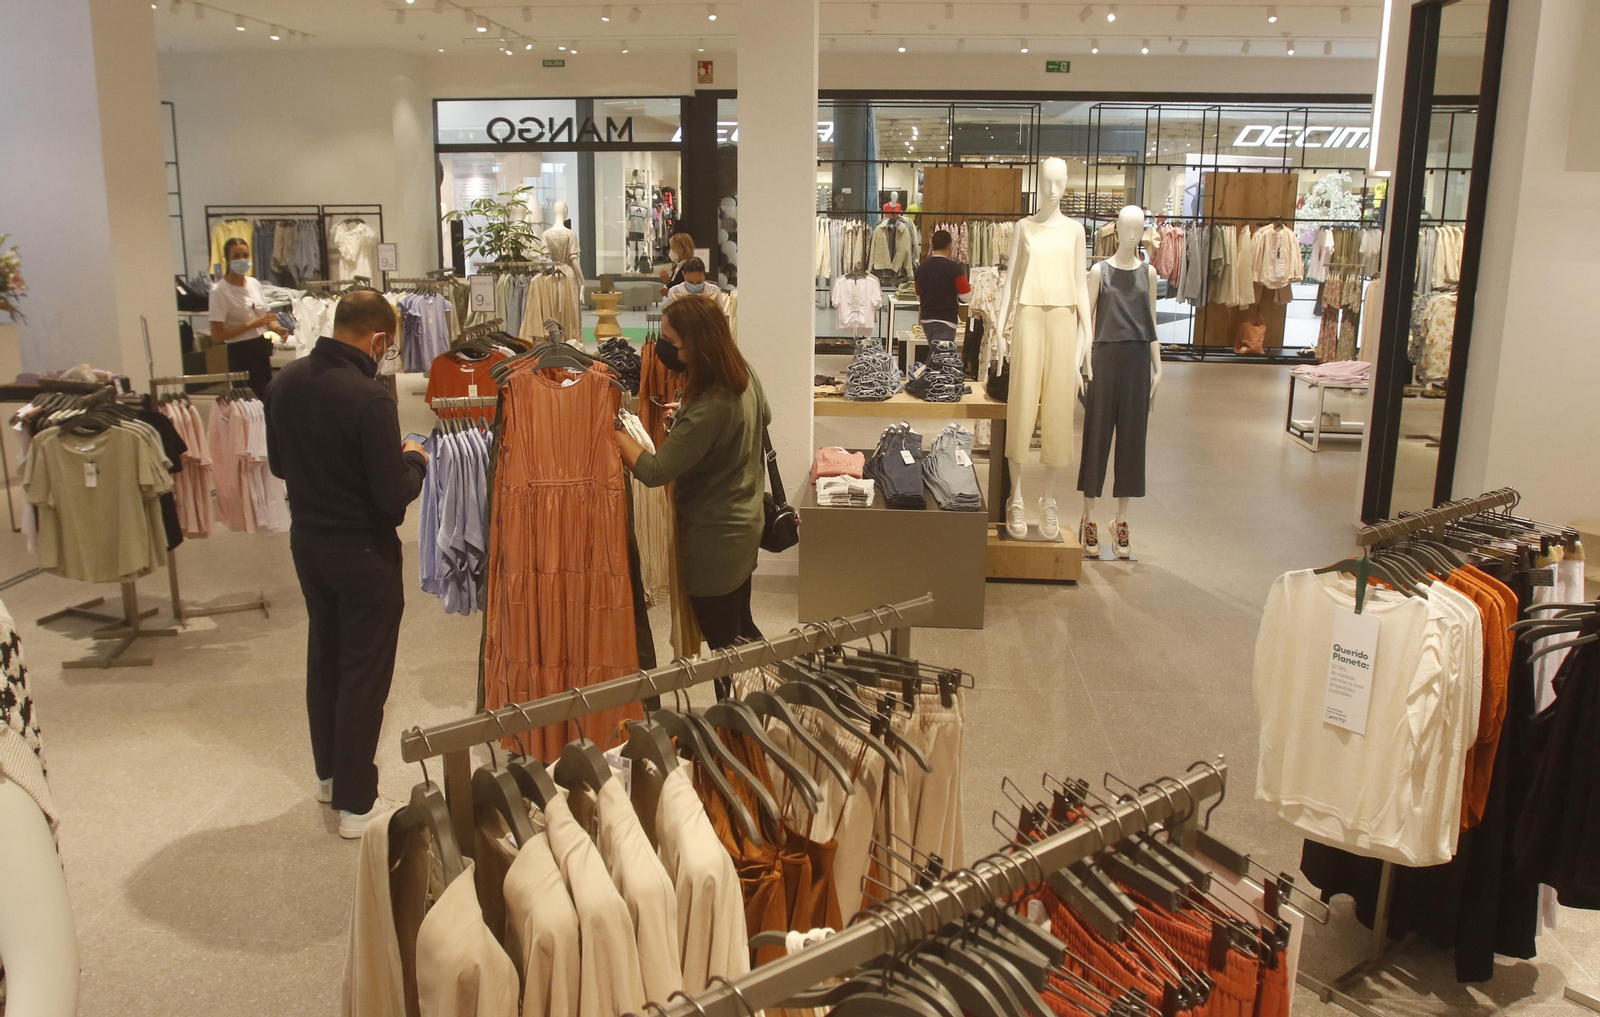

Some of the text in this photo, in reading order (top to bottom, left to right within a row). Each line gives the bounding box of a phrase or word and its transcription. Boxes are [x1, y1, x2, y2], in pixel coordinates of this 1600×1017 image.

[1232, 125, 1369, 148] DECIM
[1333, 643, 1369, 660] Querido
[1332, 652, 1370, 670] Planeta:
